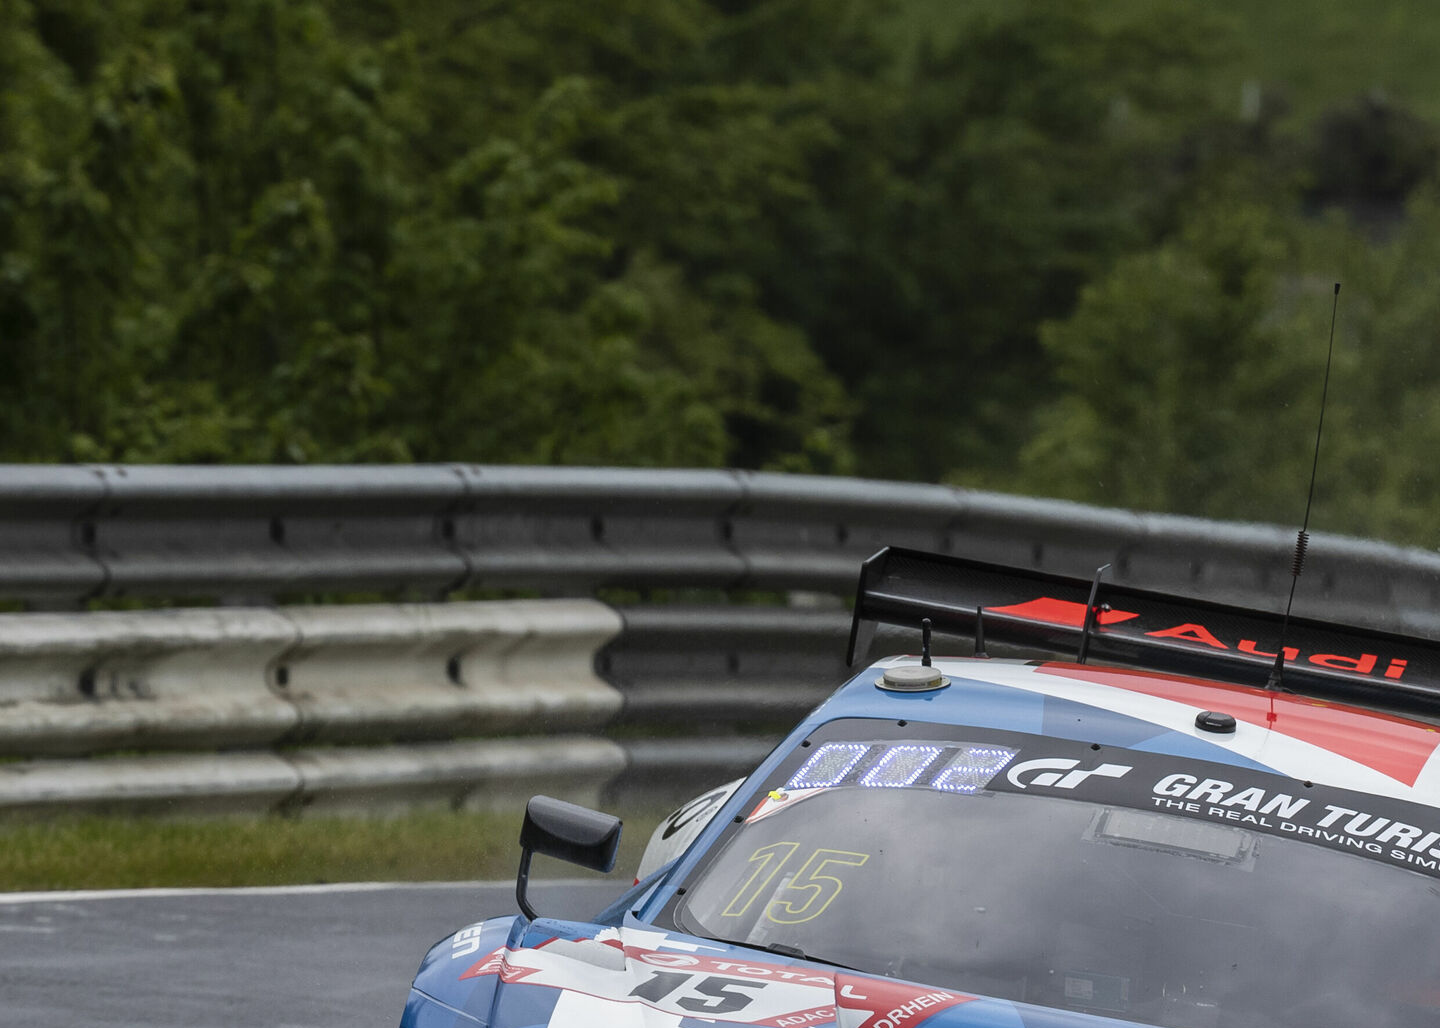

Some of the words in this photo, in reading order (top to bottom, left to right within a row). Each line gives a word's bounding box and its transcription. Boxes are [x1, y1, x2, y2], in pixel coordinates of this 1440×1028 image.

[1144, 622, 1408, 680] Audi
[1152, 773, 1311, 819] GRAN
[1152, 797, 1201, 813] THE
[1208, 807, 1273, 828] REAL
[1279, 821, 1391, 855] DRIVING
[721, 841, 870, 925] 15
[628, 970, 768, 1013] 15
[710, 959, 868, 1001] TOTAL
[775, 1008, 836, 1028] ADAC
